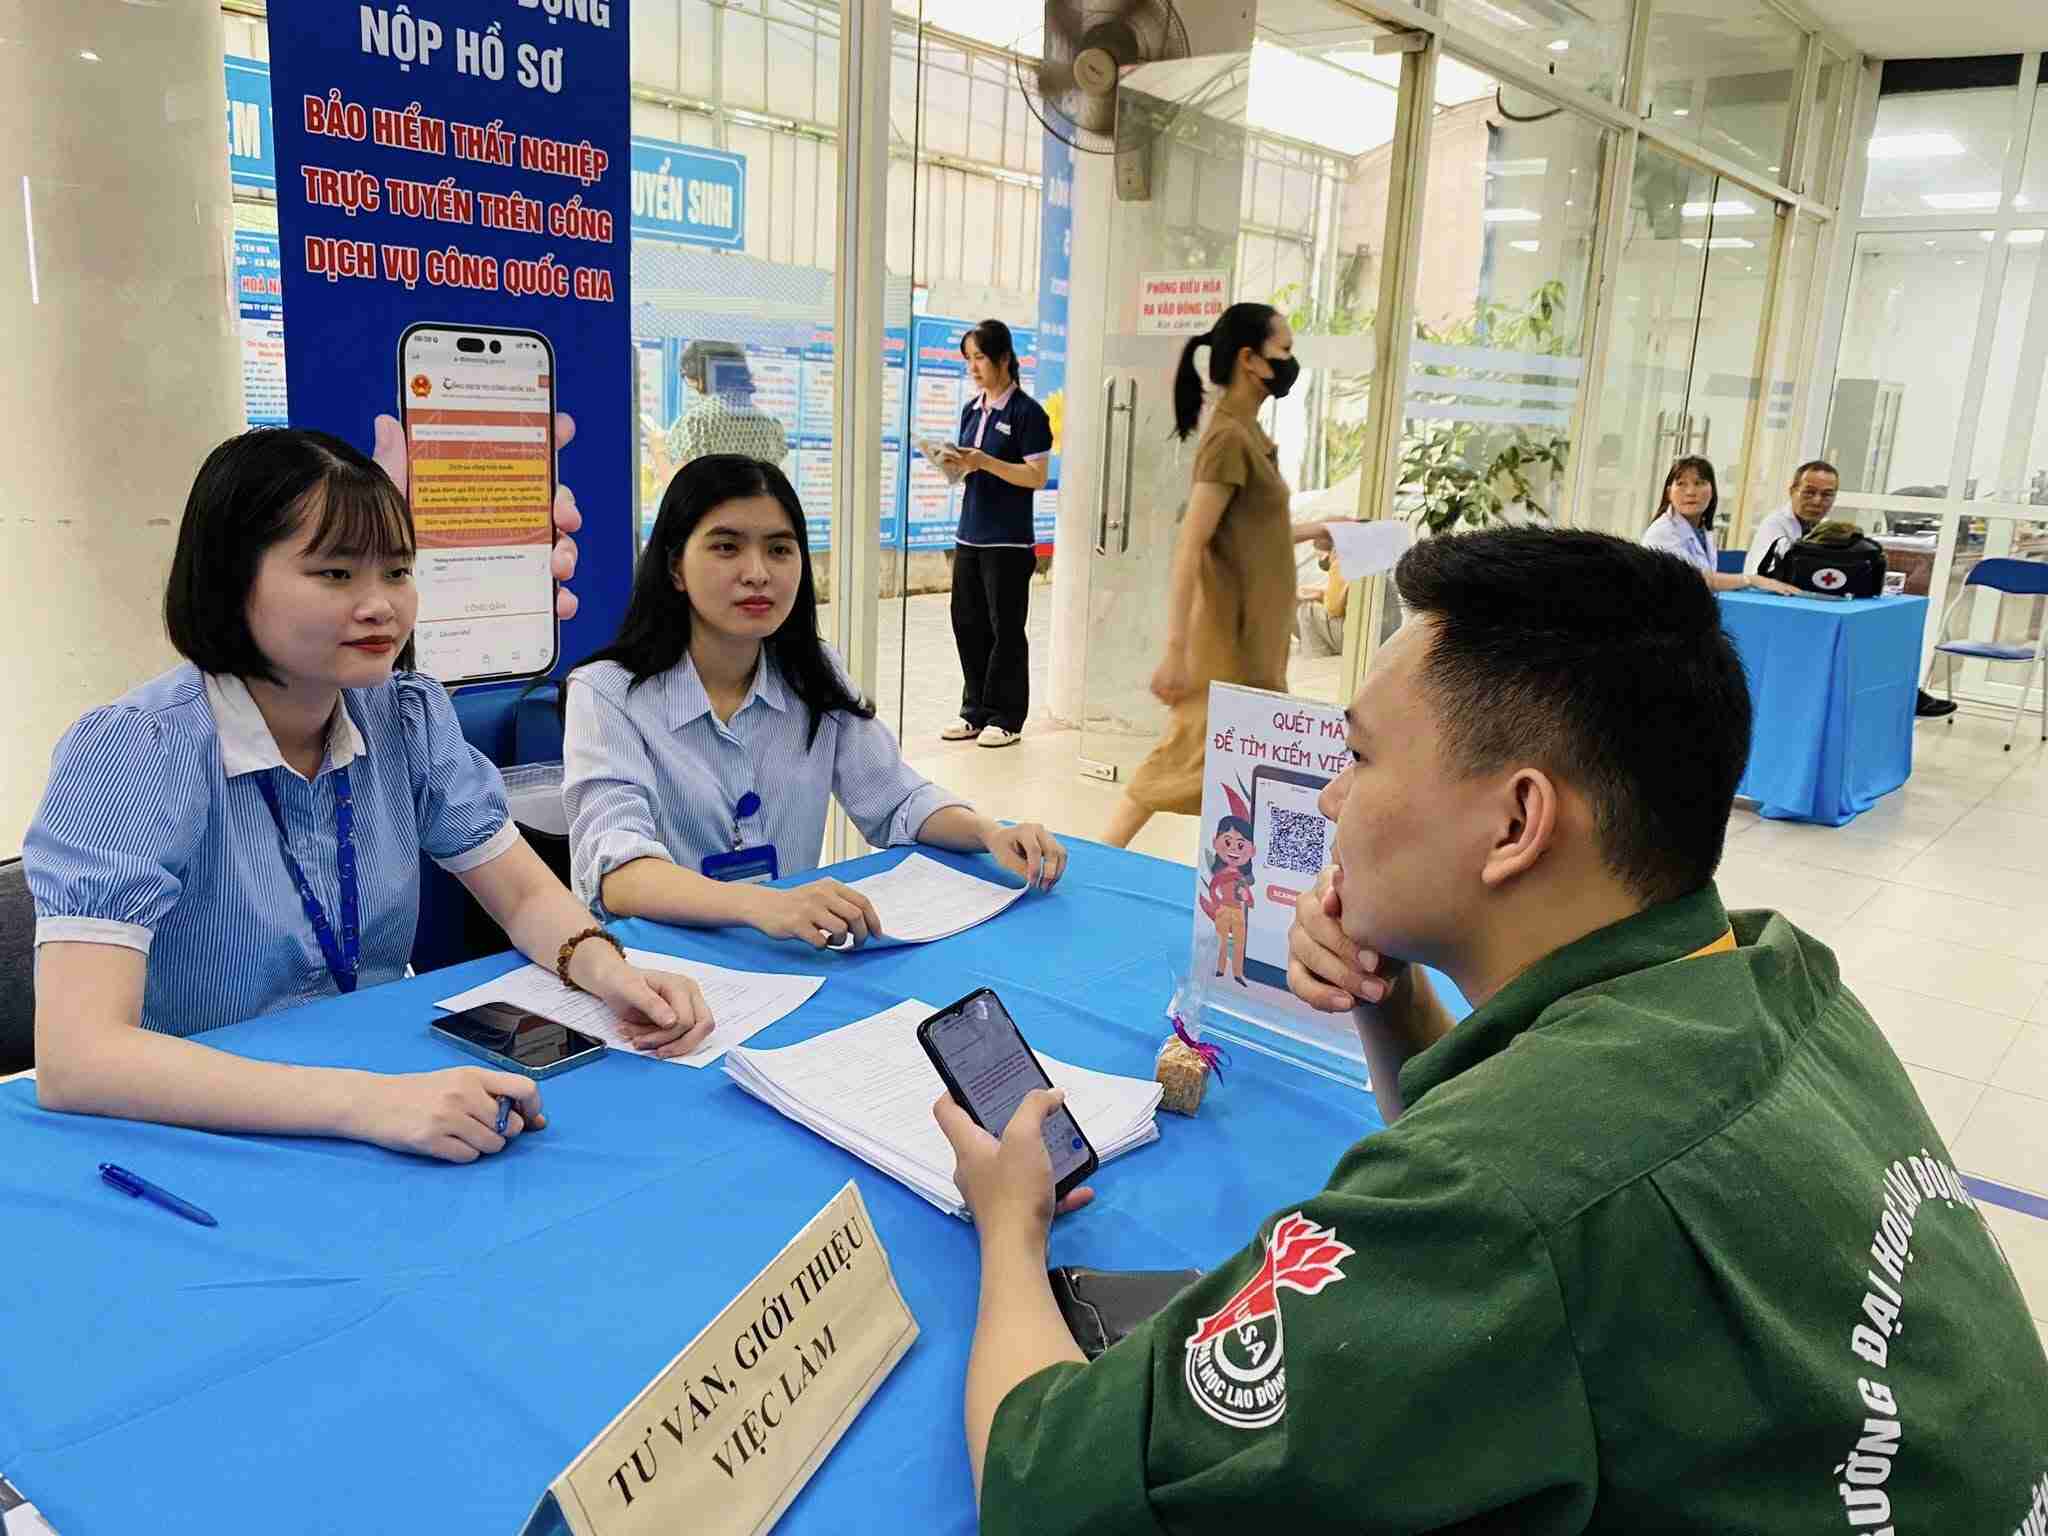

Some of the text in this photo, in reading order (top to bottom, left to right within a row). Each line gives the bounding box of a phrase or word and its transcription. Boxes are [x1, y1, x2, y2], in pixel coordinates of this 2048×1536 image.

[360, 3, 564, 94] NỘP HỒ SƠ
[304, 88, 609, 186] BẢO HIỂM THẤT NGHIỆP
[301, 165, 614, 243] TRỰC TUYẾN TRÊN CỔNG
[687, 179, 734, 229] SINH
[305, 236, 615, 303] DỊCH VỤ CÔNG QUỐC GIA
[1214, 727, 1236, 753] ĐỂ
[1240, 735, 1267, 758] TÌM
[1272, 740, 1312, 768] KIẾM
[1272, 710, 1345, 740] QUÉT MÃ
[1882, 1160, 1922, 1219] LAO
[1870, 1192, 1914, 1284] HỌC
[1852, 1270, 1903, 1368] ĐẠI
[608, 1216, 865, 1507] TƯ VẤN, GIỚI THIỆU
[711, 1324, 838, 1482] VIỆC LÀM
[1200, 1363, 1227, 1398] HỌC
[1225, 1385, 1254, 1409] LAO
[1255, 1368, 1286, 1408] ĐỘN
[1833, 1377, 1902, 1536] ƯỜNG
